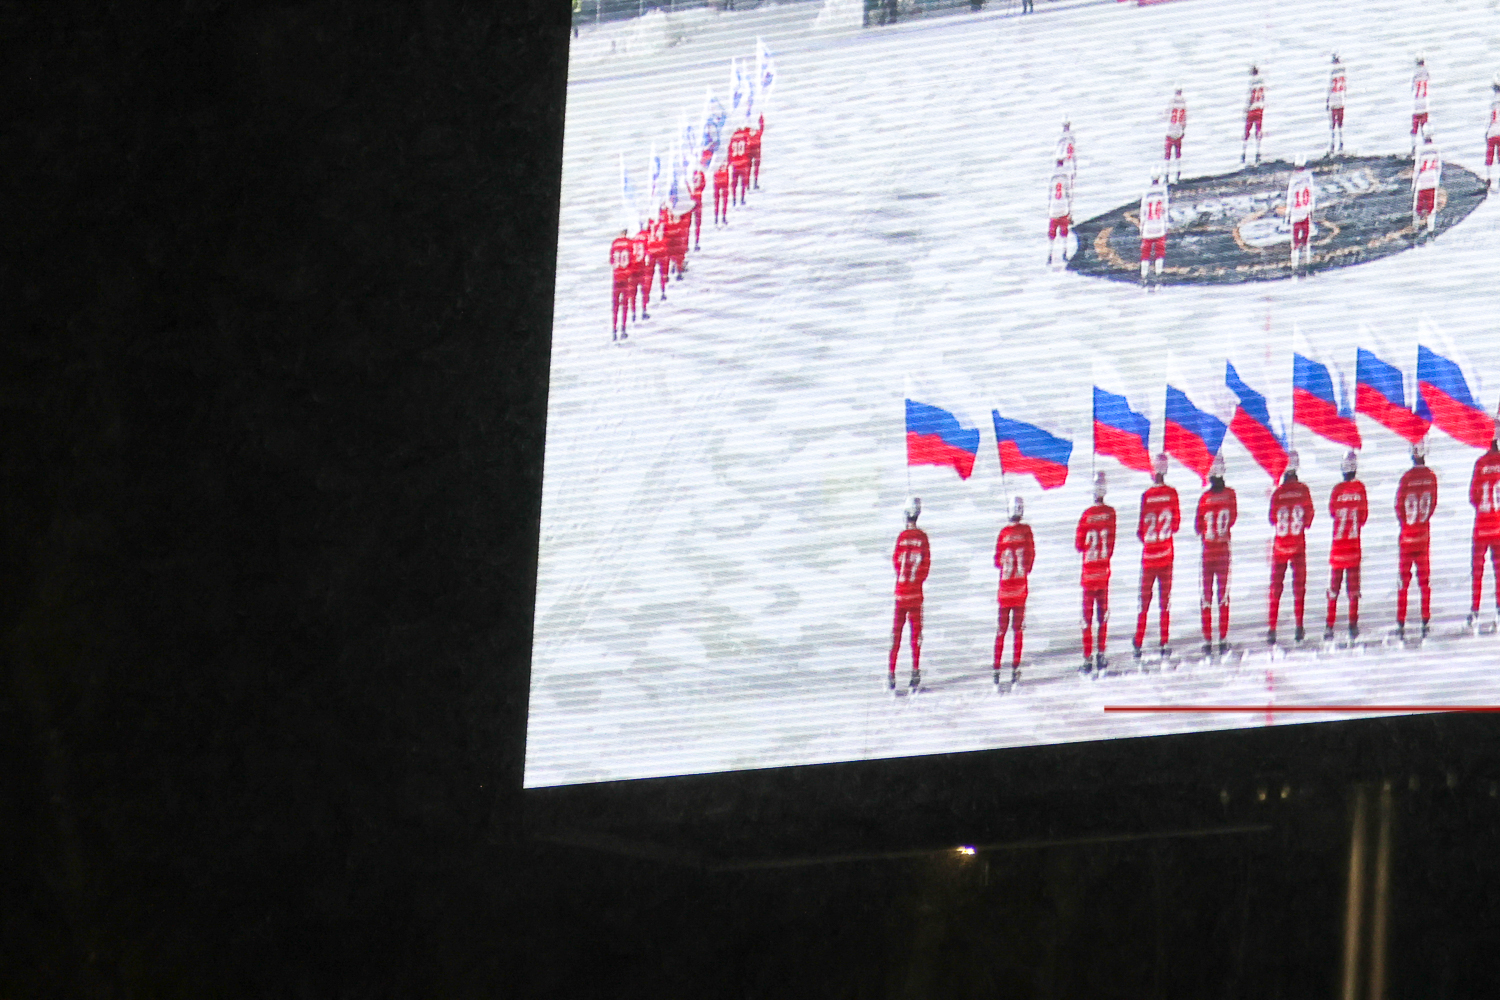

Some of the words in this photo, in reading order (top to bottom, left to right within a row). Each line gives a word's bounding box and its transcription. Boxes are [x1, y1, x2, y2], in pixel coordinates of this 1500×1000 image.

[1143, 508, 1174, 543] 22
[1276, 503, 1305, 537] 88
[1084, 528, 1109, 563] 21
[898, 550, 923, 583] 17
